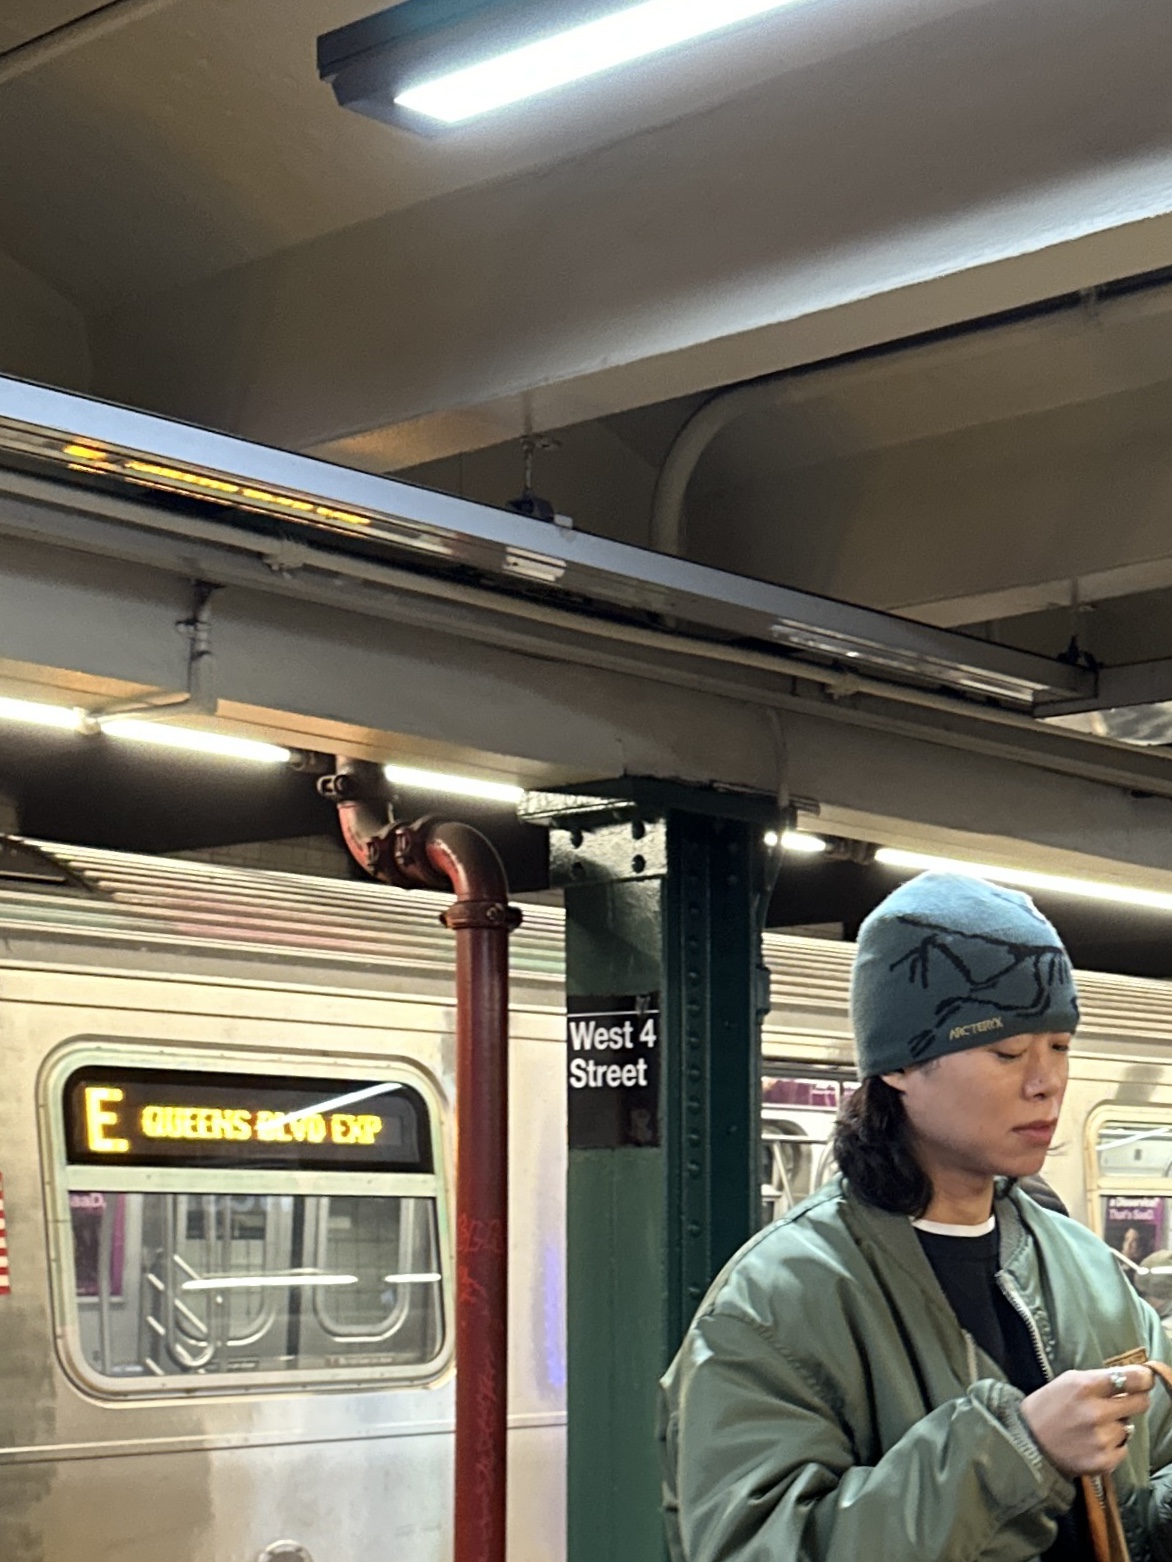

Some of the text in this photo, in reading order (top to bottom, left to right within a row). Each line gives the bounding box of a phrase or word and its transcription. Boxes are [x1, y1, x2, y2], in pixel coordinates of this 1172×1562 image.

[569, 1018, 657, 1051] West 4
[569, 1057, 648, 1089] Street
[85, 1086, 130, 1152] E
[141, 1105, 252, 1140] QUEENS
[330, 1112, 382, 1144] EXP
